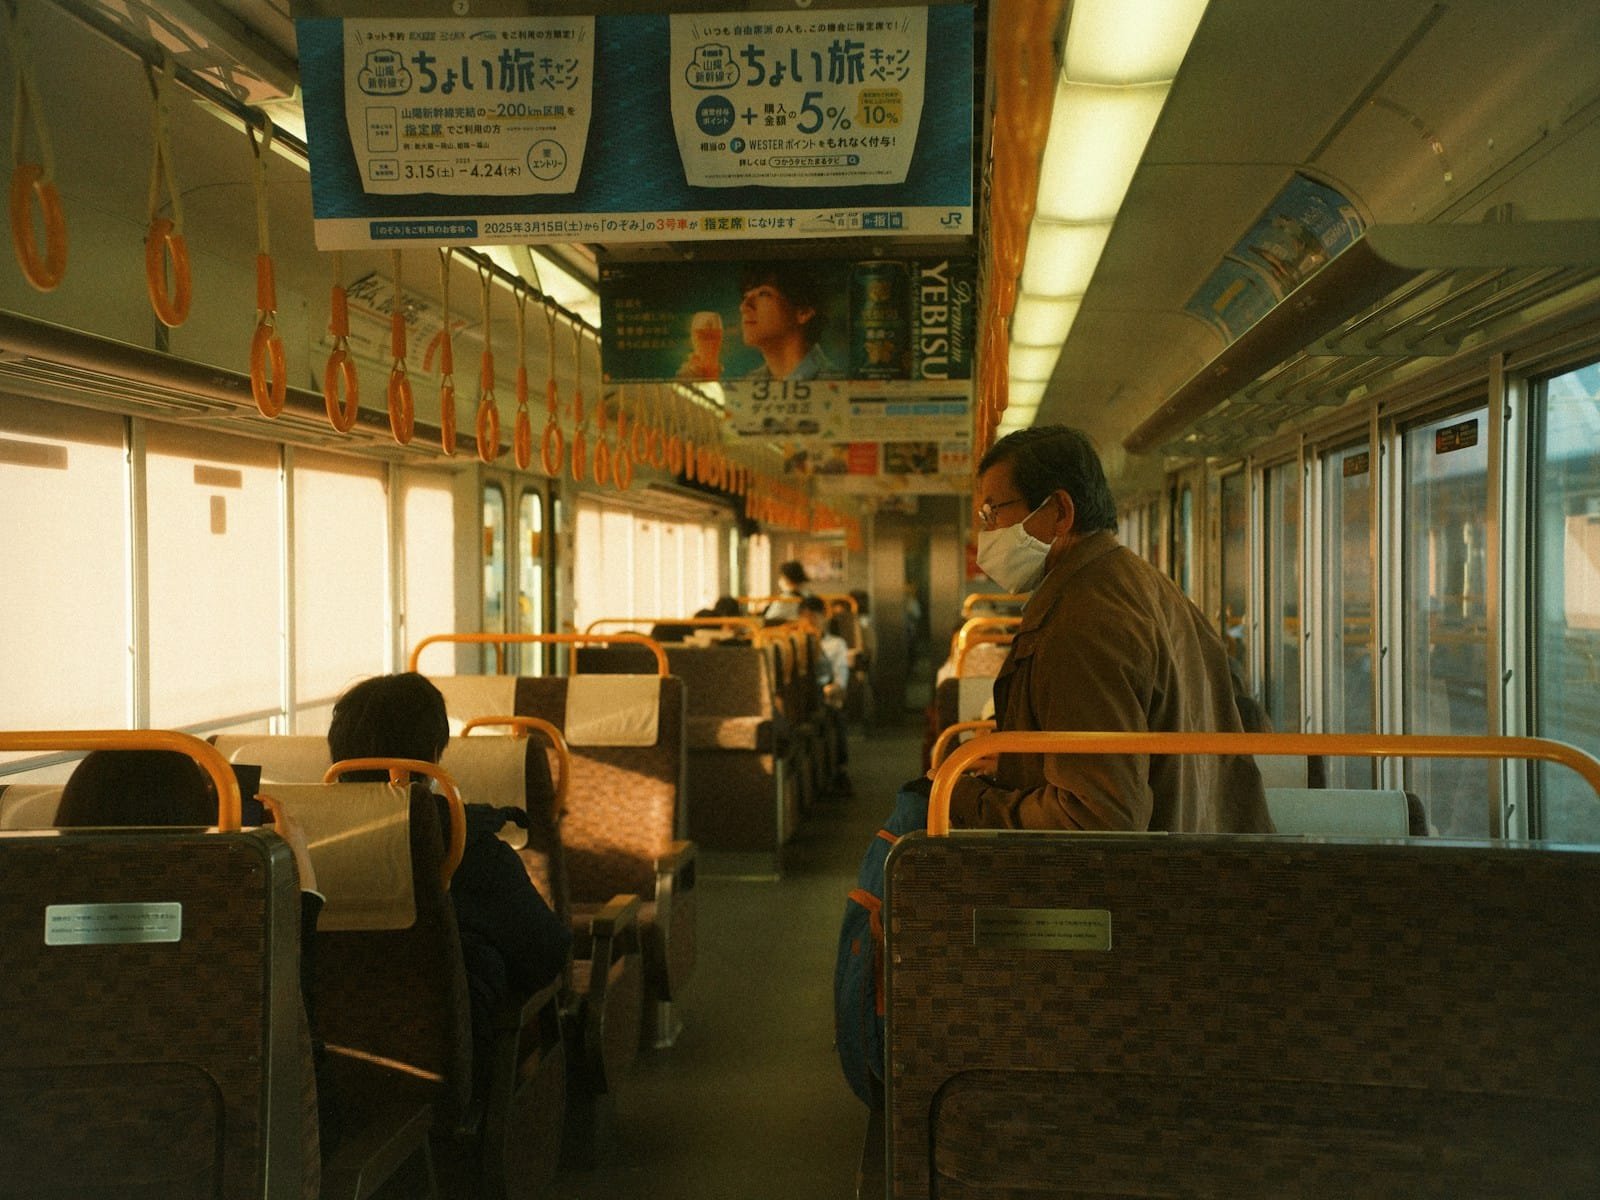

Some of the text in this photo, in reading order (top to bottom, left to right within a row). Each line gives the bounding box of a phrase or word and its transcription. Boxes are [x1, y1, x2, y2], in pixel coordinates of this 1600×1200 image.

[740, 39, 865, 87] ちょい旅
[869, 48, 910, 64] キャン
[411, 48, 535, 95] ちょい旅
[539, 57, 579, 72] キャン
[869, 66, 910, 82] ペーン
[539, 75, 579, 91] ペーン
[796, 91, 851, 134] 5%
[863, 105, 899, 124] 10%
[533, 159, 563, 169] エントリー
[940, 212, 963, 224] JR
[920, 260, 949, 379] YEBISU
